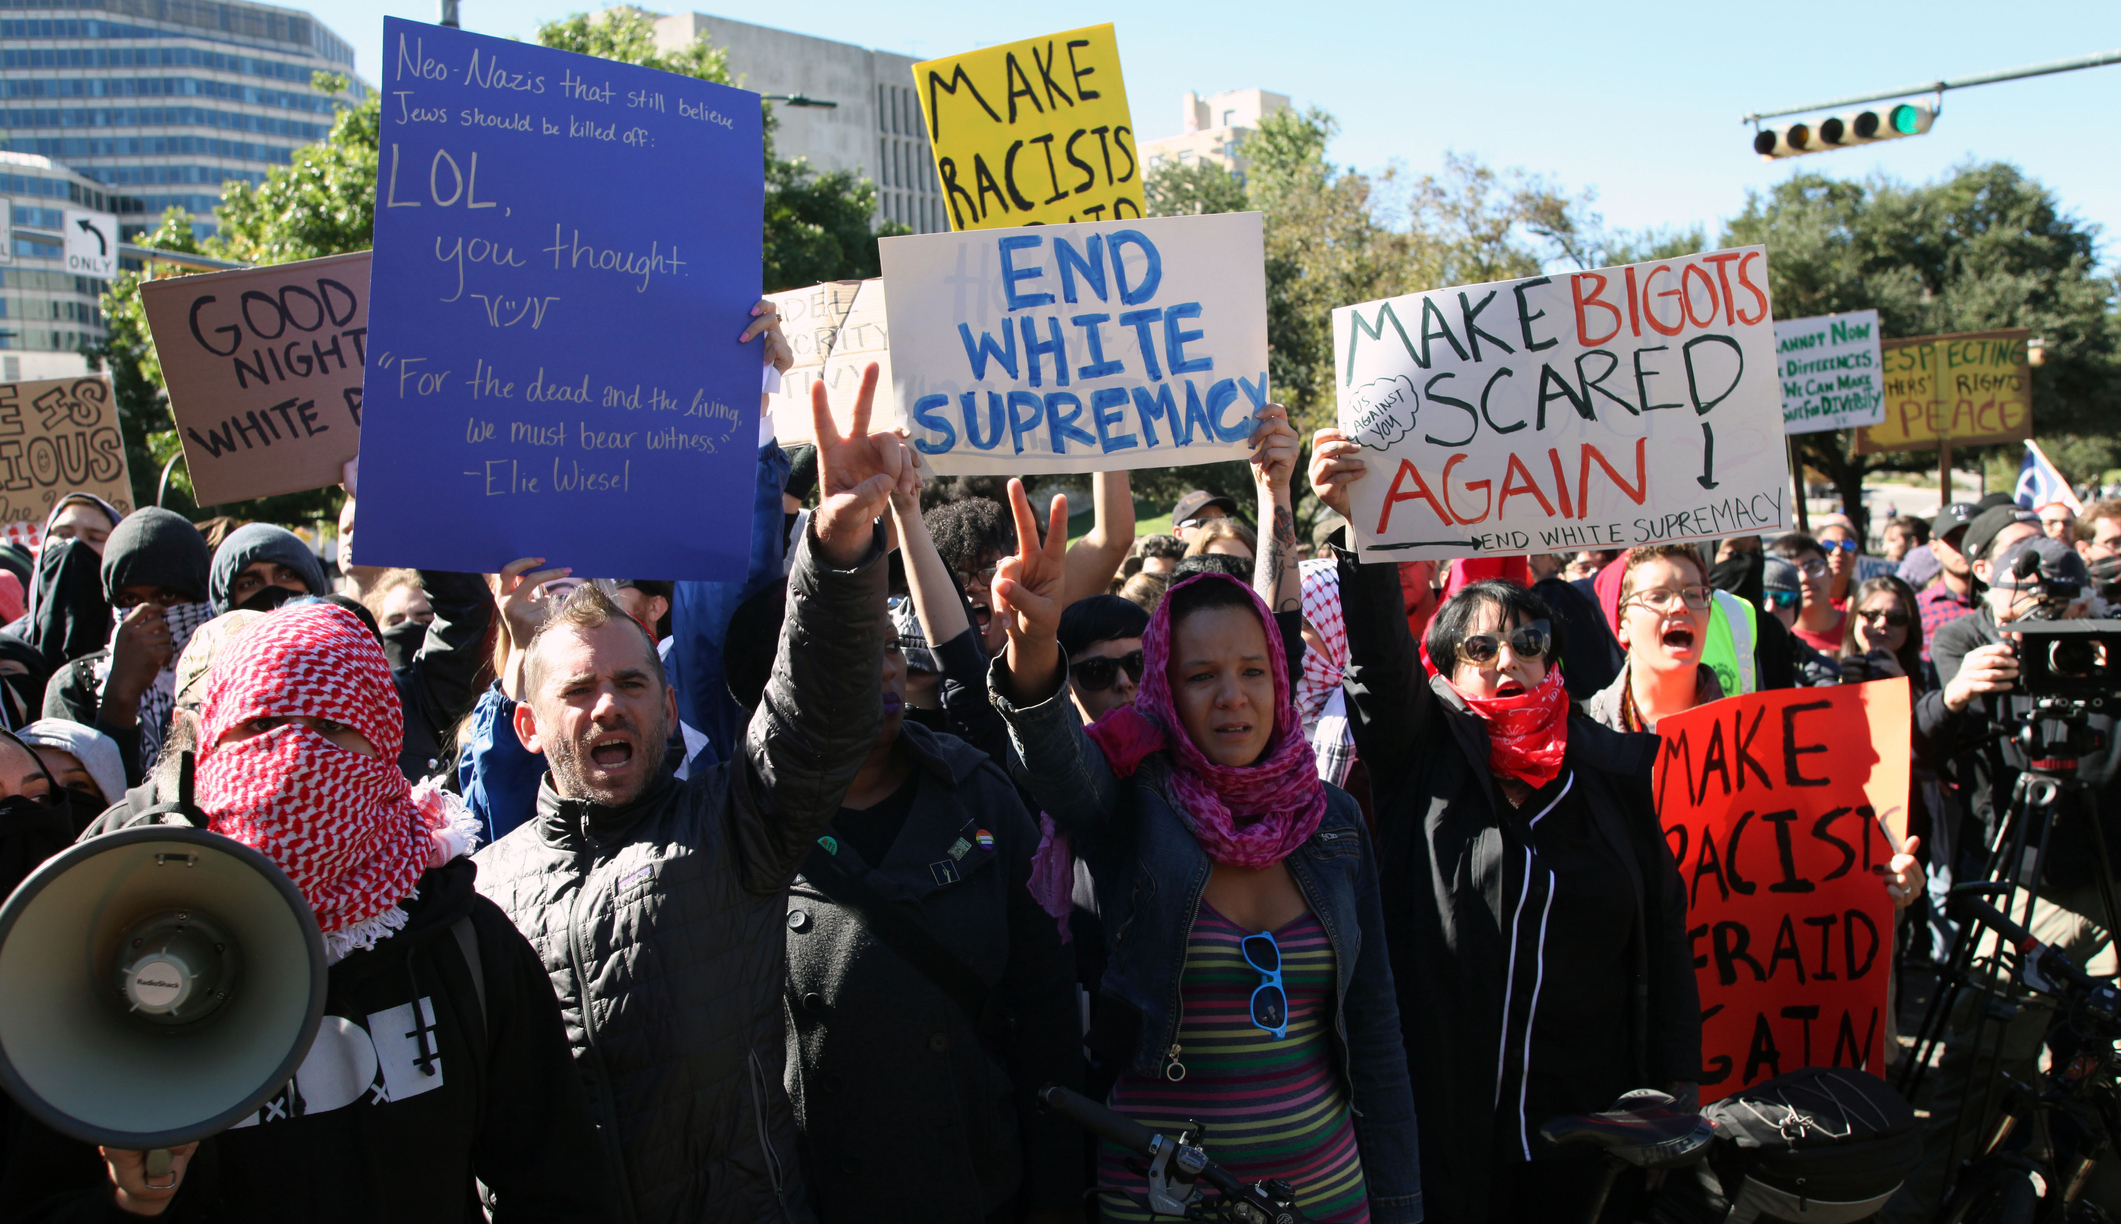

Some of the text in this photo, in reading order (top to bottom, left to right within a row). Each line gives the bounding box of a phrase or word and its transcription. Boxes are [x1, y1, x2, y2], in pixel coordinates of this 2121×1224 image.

[396, 32, 734, 130] Neo-Nazis that still believe
[928, 39, 1100, 144] MAKE
[393, 90, 656, 148] Jews should be killed off:
[387, 143, 512, 218] LOL,
[938, 125, 1136, 229] RACISTS
[69, 254, 113, 274] ONLY
[435, 223, 689, 302] you thought.
[998, 229, 1163, 312] END
[189, 277, 357, 357] GOOD
[777, 290, 859, 322] DEL
[1346, 251, 1769, 387] MAKE BIGOTS
[233, 326, 367, 389] NIGHT
[957, 301, 1214, 388] WHITE
[1882, 338, 2028, 374] ESPECTING
[32, 378, 108, 431] IS
[466, 358, 515, 400] the
[526, 366, 594, 403] dead
[603, 384, 643, 410] and
[648, 387, 679, 411] the
[683, 388, 743, 433] living,
[912, 371, 1268, 455] SUPREMACY
[1352, 395, 1371, 414] US
[1353, 388, 1405, 433] AGAINST
[1424, 333, 1744, 447] SCARED
[1899, 395, 2023, 438] PEACE
[1956, 372, 2026, 396] RIGHTS
[0, 426, 124, 491] IOUS
[187, 397, 330, 459] WHITE
[510, 421, 568, 447] must
[580, 421, 639, 450] bear
[1369, 414, 1402, 441] YOU
[553, 456, 630, 493] Wiesel
[1376, 436, 1648, 535] AGAIN
[1481, 487, 1783, 550] END WHITE SUPREMACY
[1657, 699, 1834, 819] MAKE
[1688, 908, 1880, 987] FRAID
[136, 978, 180, 989] RadioShack
[1701, 1002, 1879, 1087] GAIN
